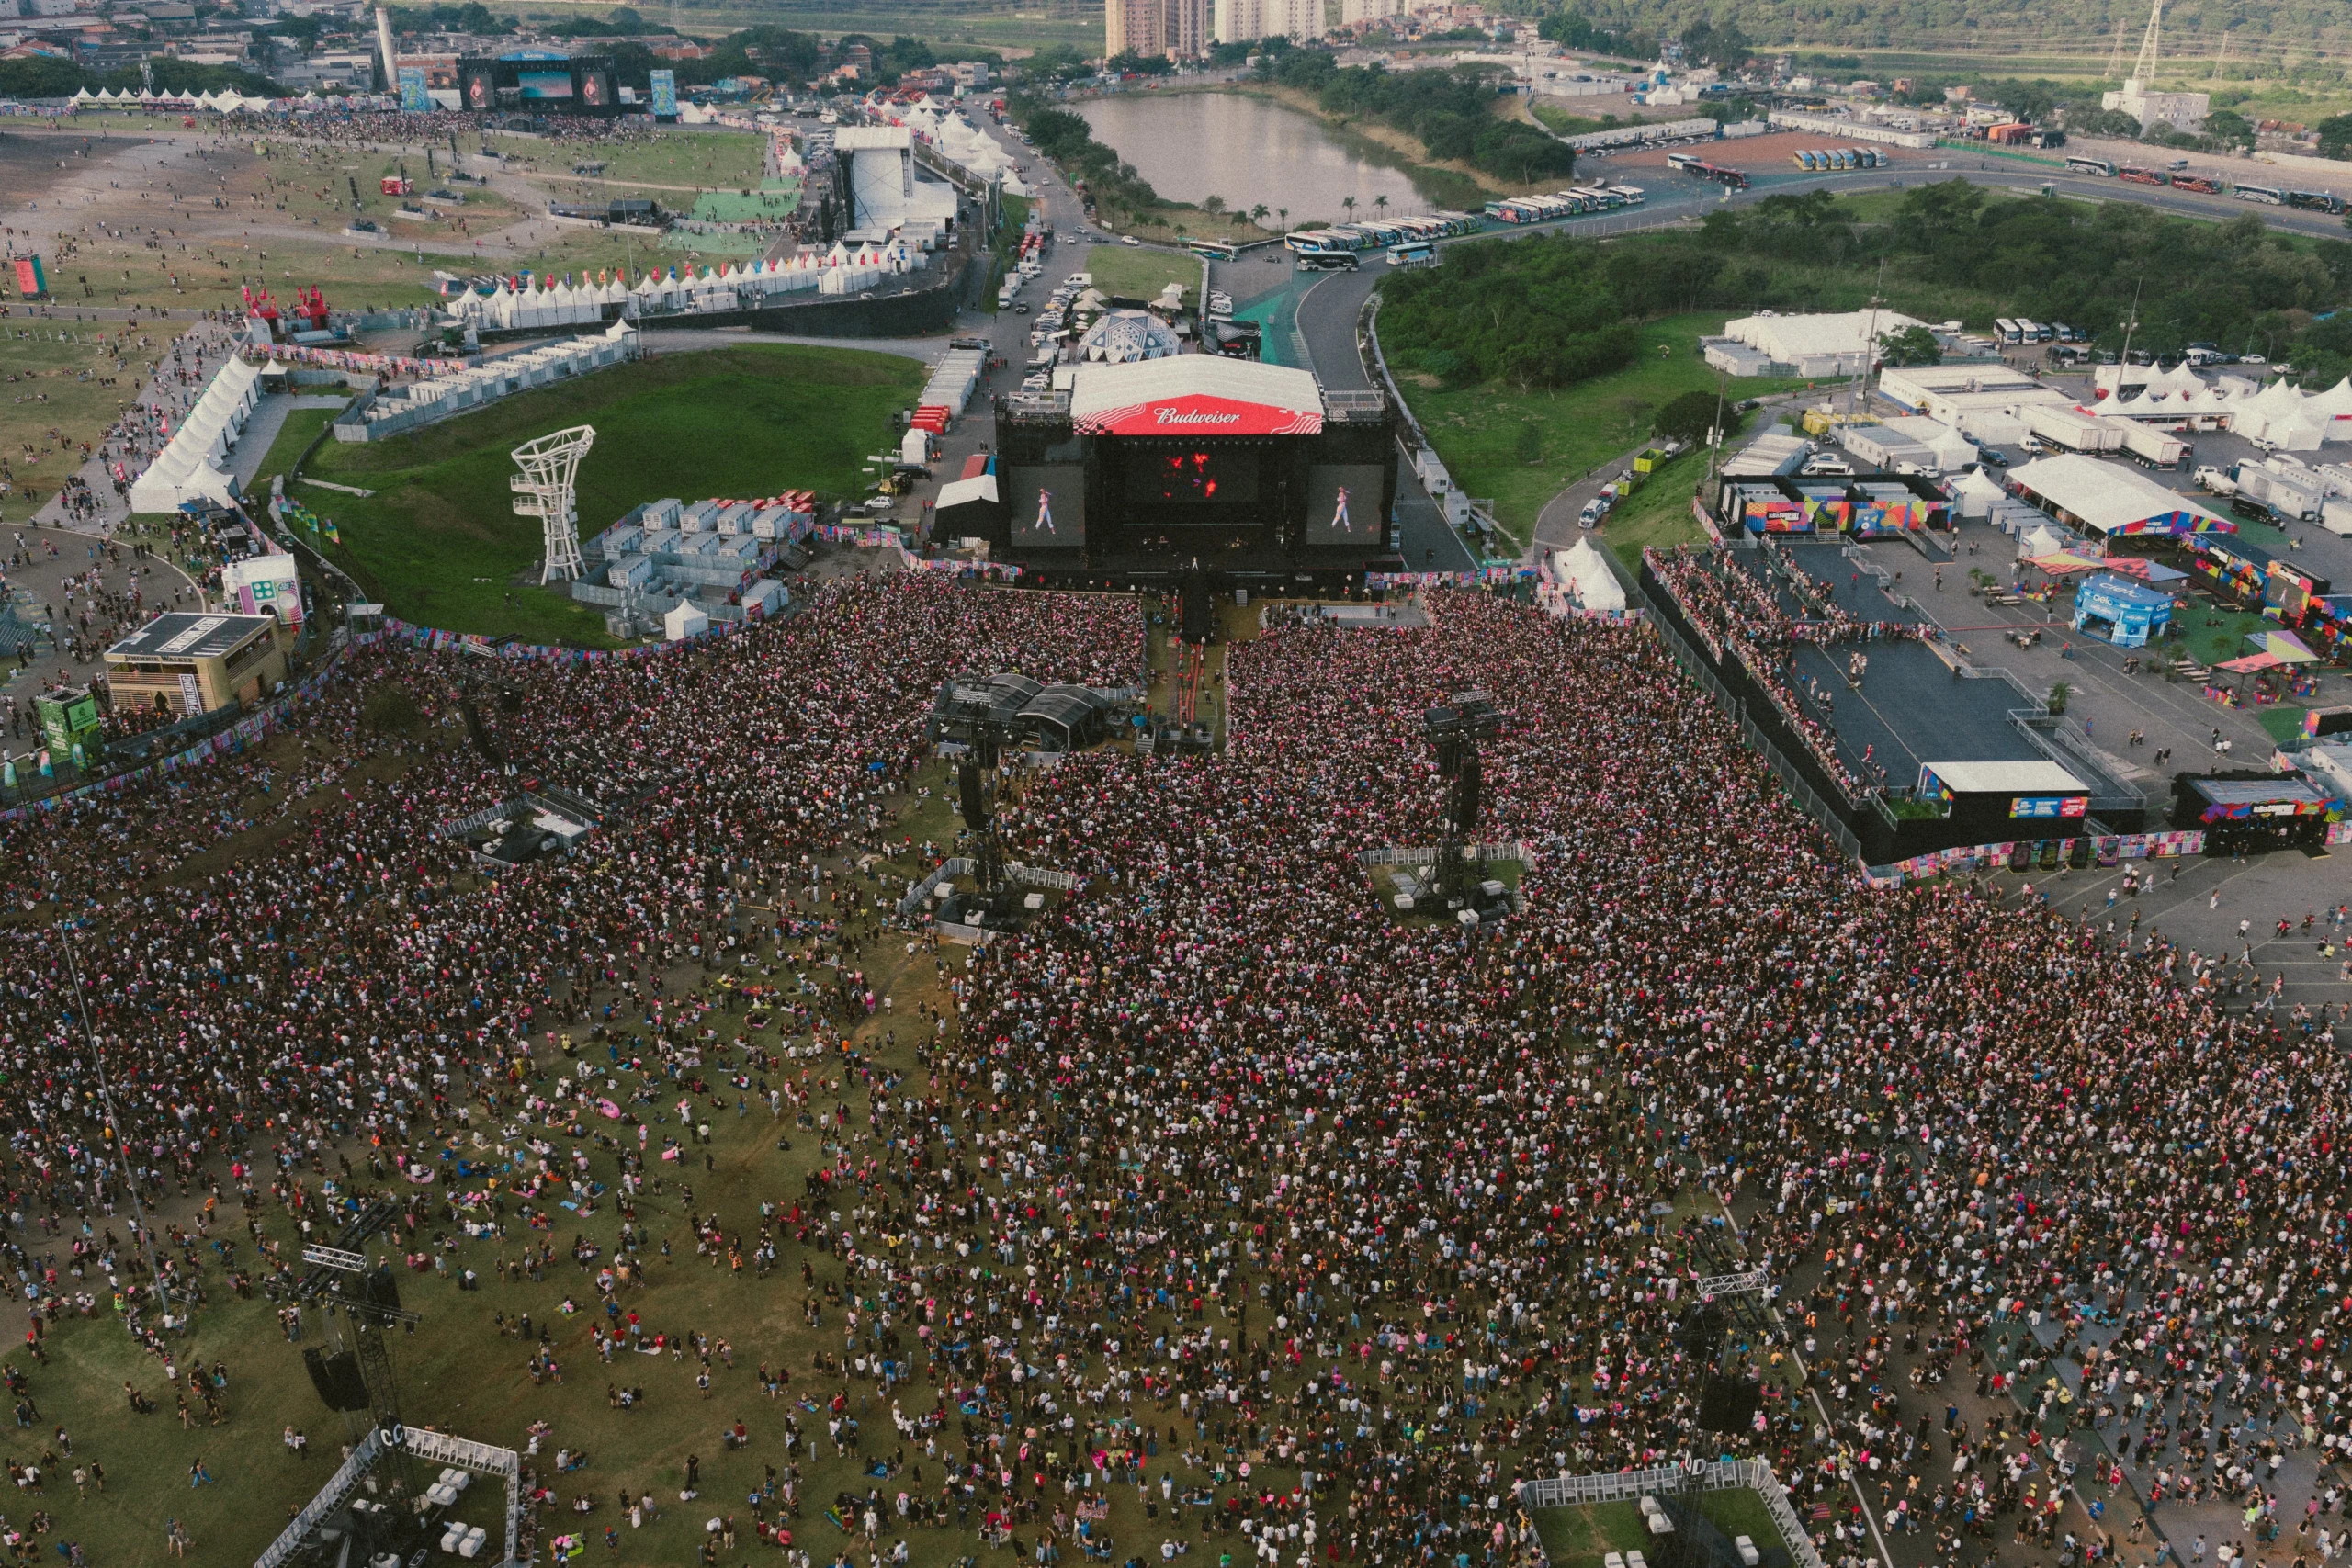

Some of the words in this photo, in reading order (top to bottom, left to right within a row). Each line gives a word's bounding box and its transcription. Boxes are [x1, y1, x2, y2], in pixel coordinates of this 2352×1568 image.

[1153, 407, 1240, 425] Budweiser
[2099, 582, 2143, 599] cielo
[2092, 594, 2113, 606] cielo
[182, 675, 198, 705] WALKING
